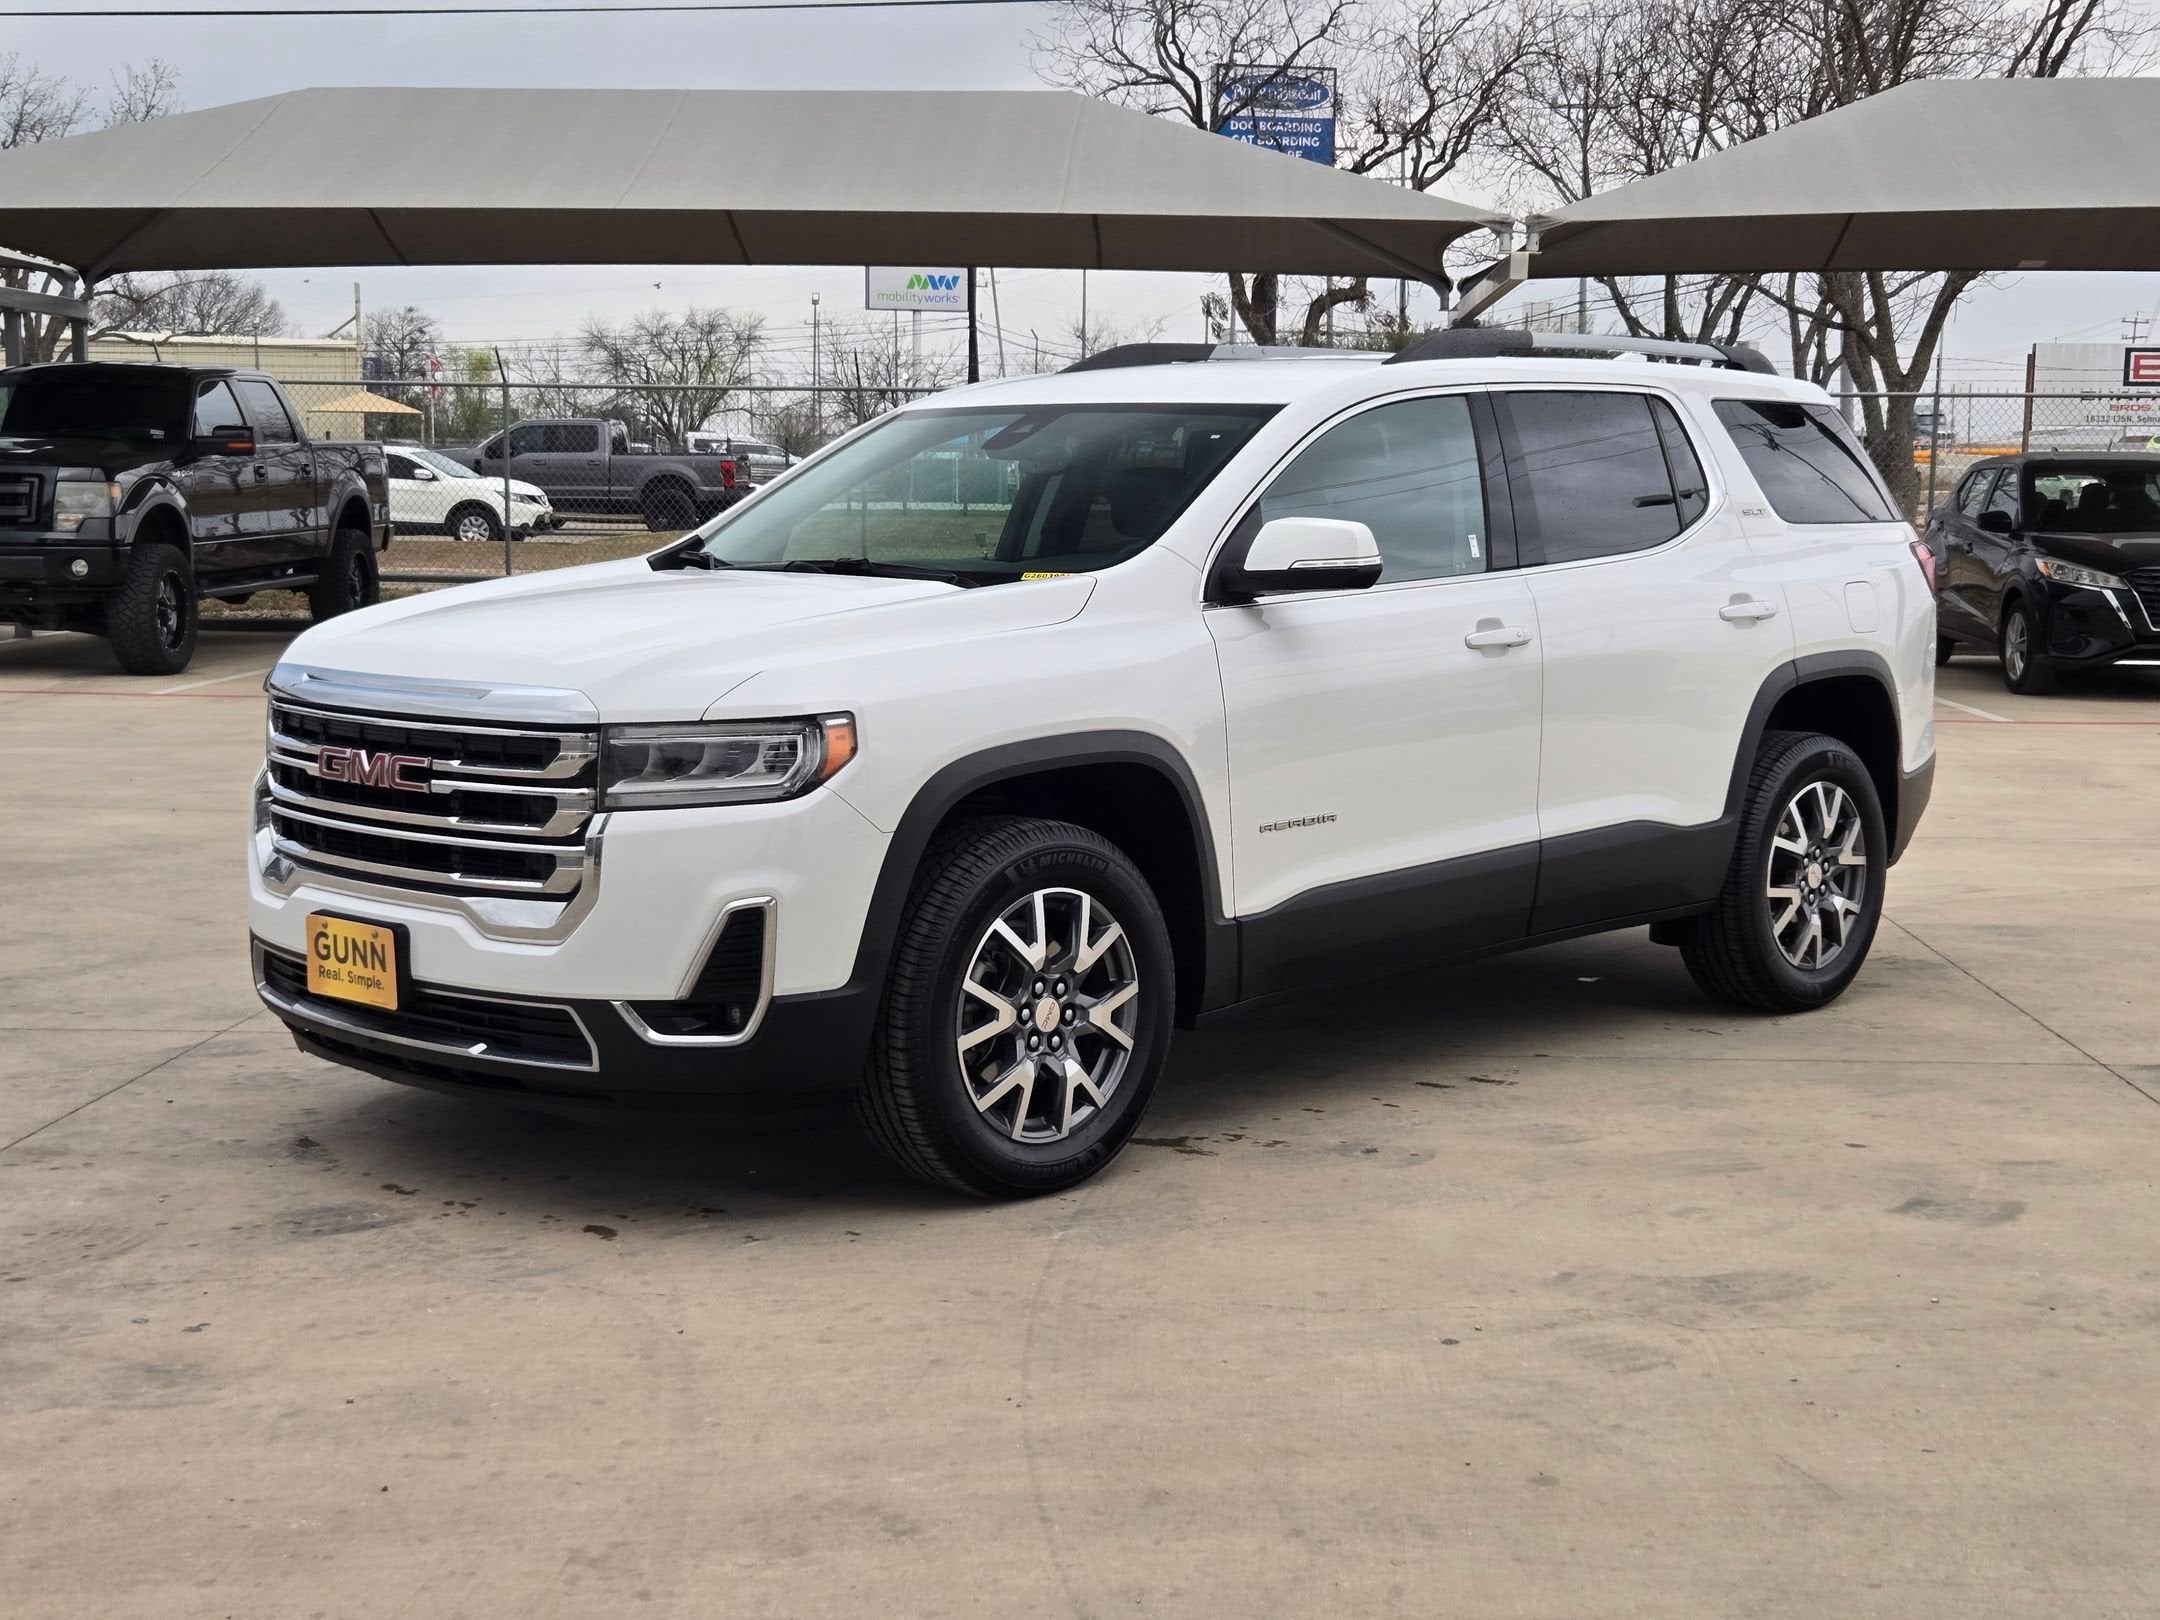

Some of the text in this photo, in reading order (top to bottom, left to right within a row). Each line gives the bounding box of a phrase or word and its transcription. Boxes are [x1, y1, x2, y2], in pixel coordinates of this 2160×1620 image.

[1260, 121, 1322, 133] BOARDING
[877, 291, 959, 304] mobilityworks
[318, 745, 433, 794] GMC
[1039, 852, 1110, 873] MICHELIN
[313, 930, 387, 973] GUNN
[318, 964, 385, 991] Real. Simple.
